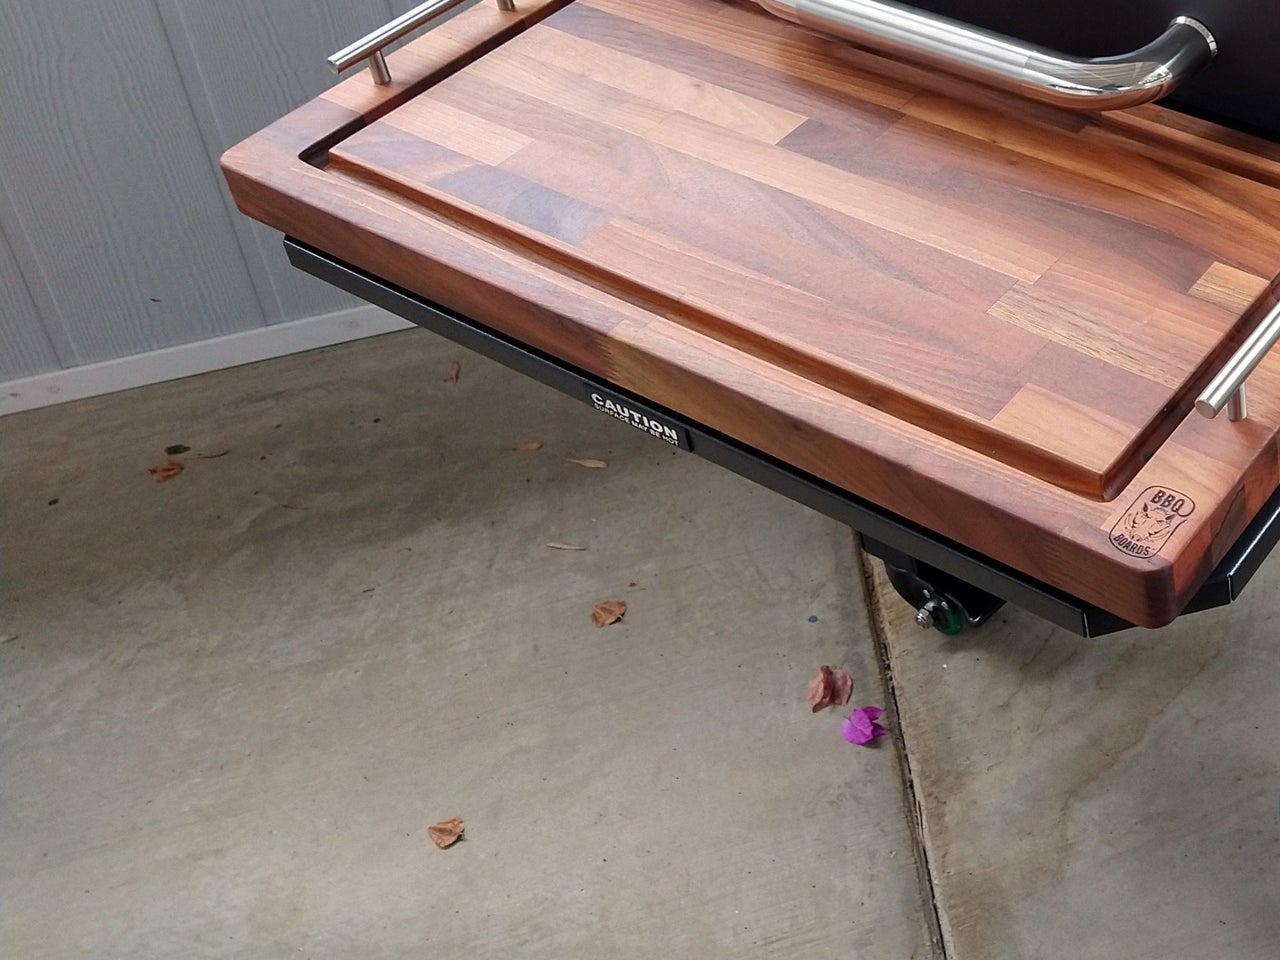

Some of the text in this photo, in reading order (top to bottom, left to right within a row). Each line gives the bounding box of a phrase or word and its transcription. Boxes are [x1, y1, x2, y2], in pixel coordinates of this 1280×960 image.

[591, 393, 678, 440] CAUTION
[594, 403, 630, 424] SURFACE
[631, 420, 648, 432] MAY
[650, 429, 661, 439] BE
[1150, 489, 1185, 513] BBQ
[1113, 533, 1151, 556] BOARDS
